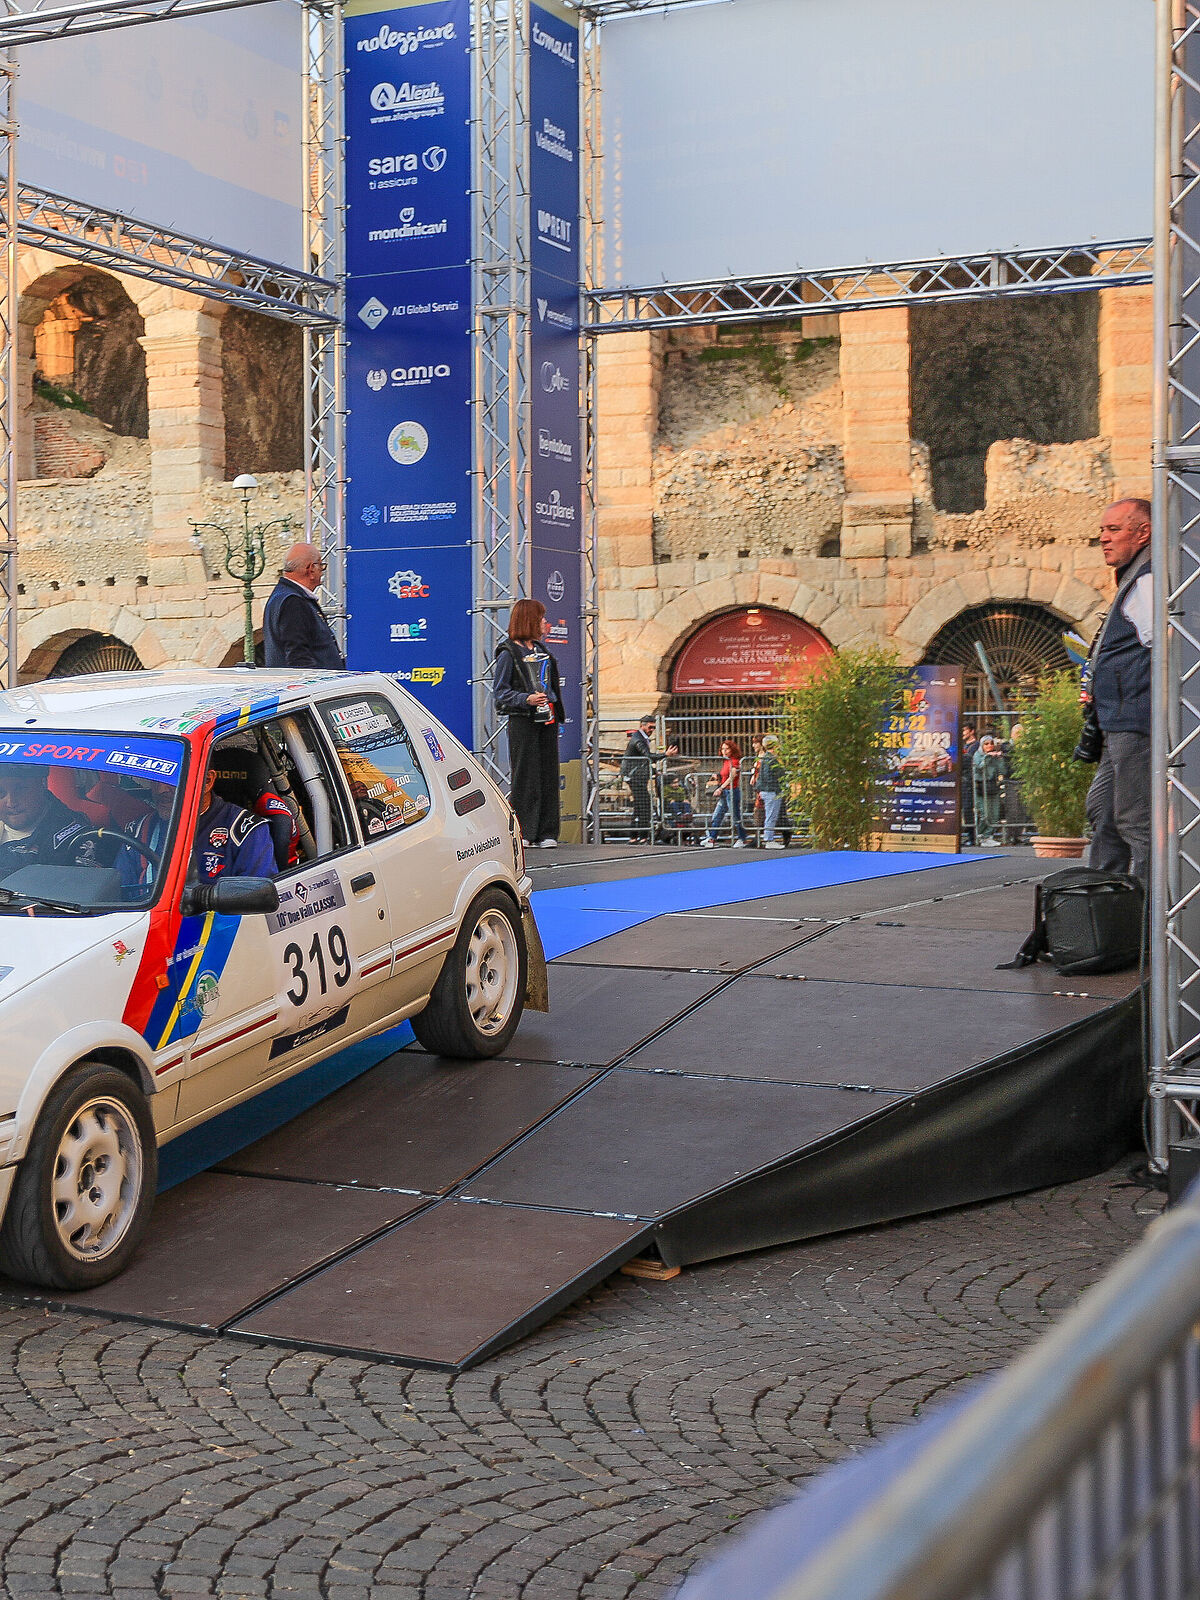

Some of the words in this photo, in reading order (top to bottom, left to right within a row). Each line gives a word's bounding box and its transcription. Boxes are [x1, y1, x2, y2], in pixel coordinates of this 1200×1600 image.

[357, 22, 455, 55] noleggiare
[368, 154, 418, 175] sara
[377, 176, 418, 189] assicura
[368, 219, 447, 242] mondinicavi
[390, 364, 451, 381] amia
[400, 585, 430, 598] SEC
[23, 744, 105, 762] SPORT
[367, 782, 387, 799] milk
[456, 846, 475, 861] Banca
[474, 836, 501, 854] Valsabbina
[312, 895, 337, 914] CLASSIC
[282, 924, 352, 1007] 319
